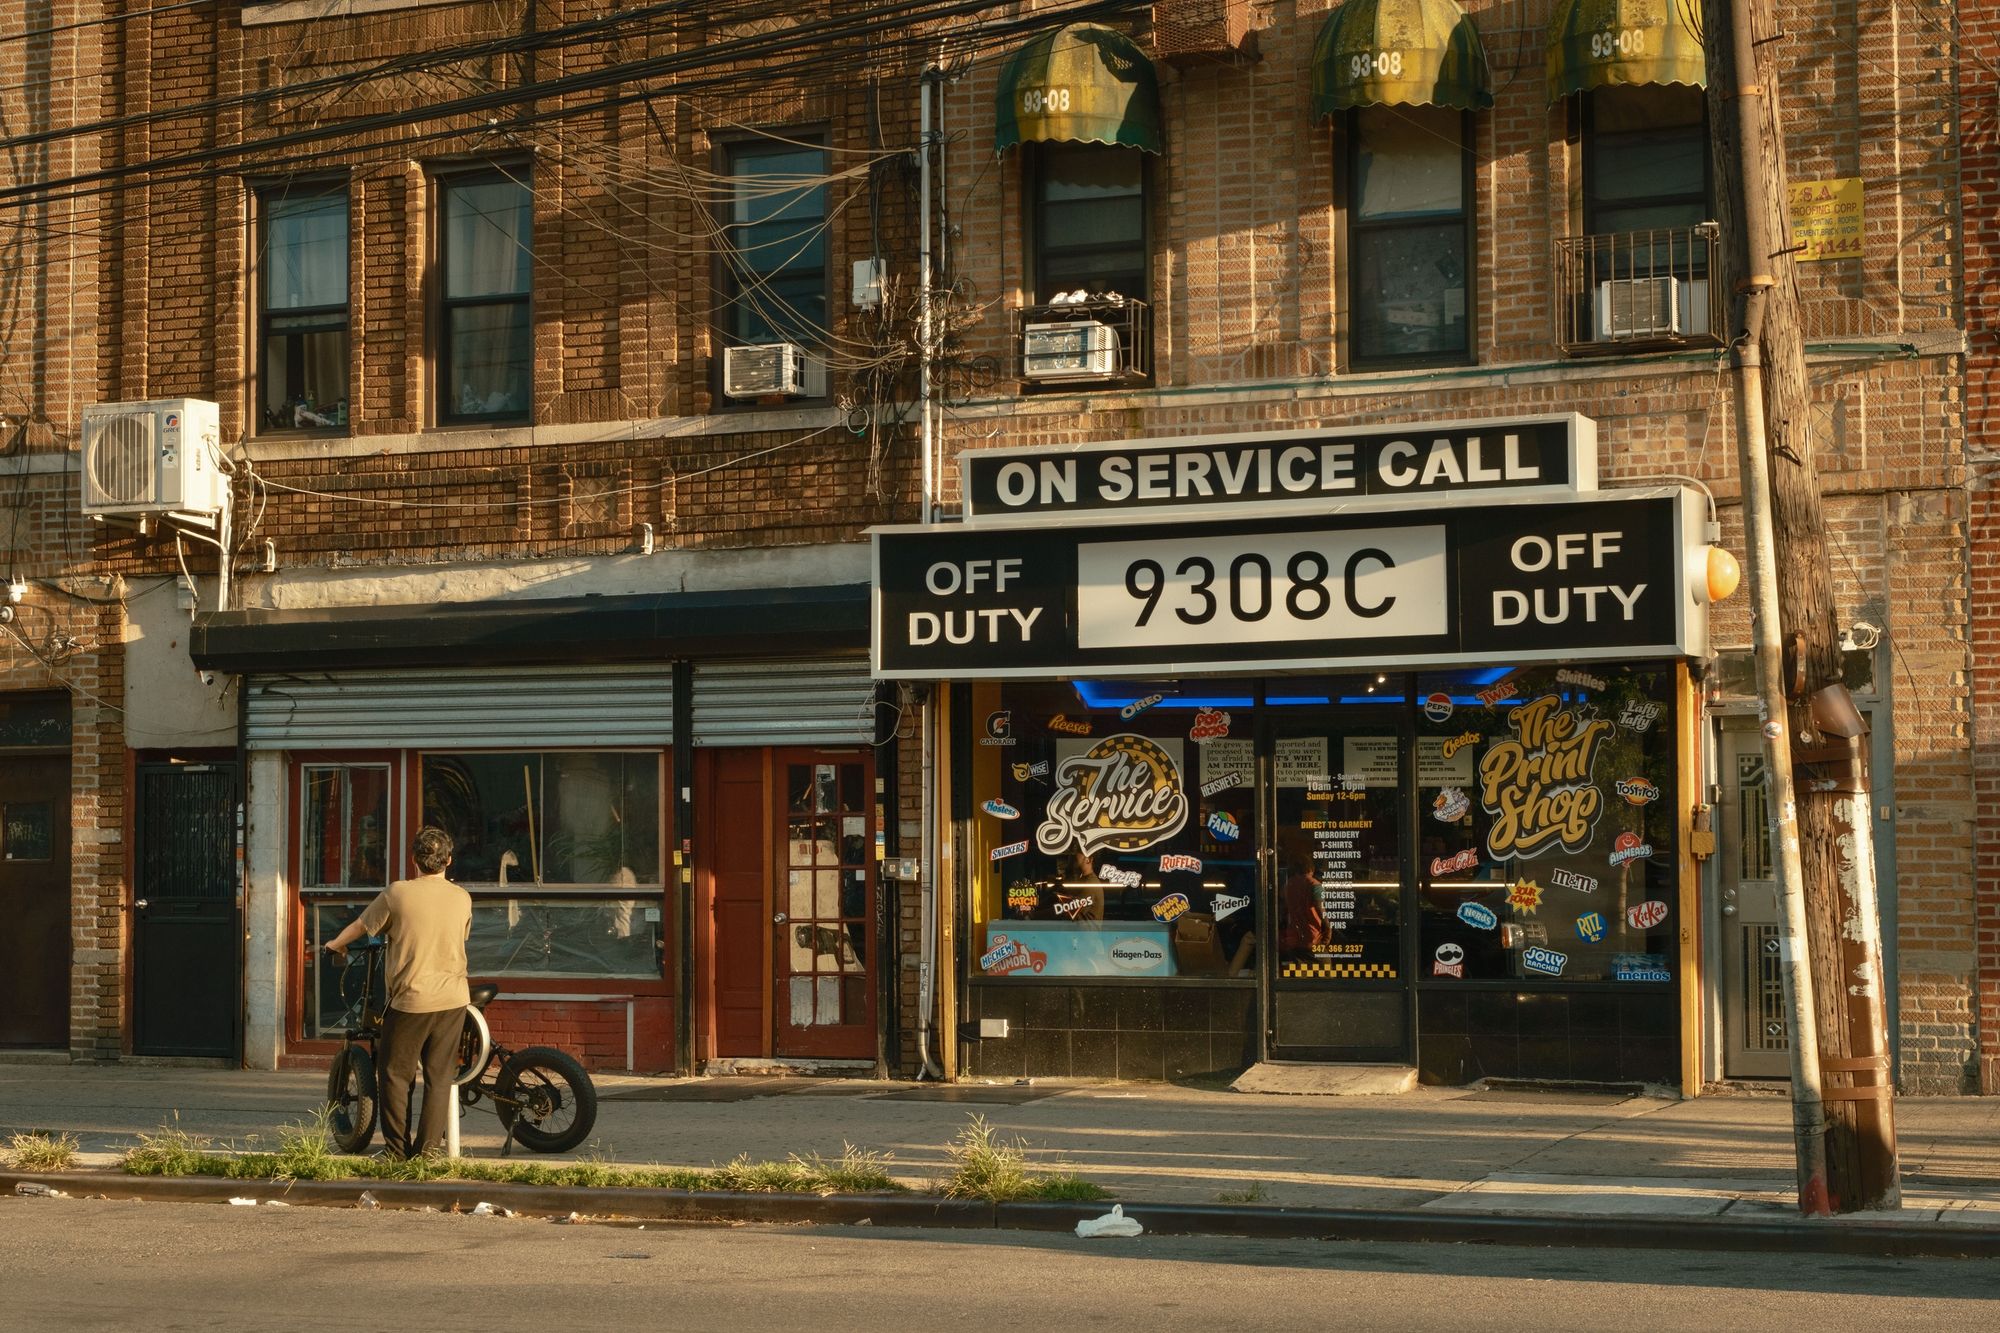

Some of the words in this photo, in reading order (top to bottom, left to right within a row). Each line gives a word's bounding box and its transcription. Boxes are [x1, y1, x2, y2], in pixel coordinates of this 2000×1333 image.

[1591, 30, 1644, 58] 93-08
[1351, 52, 1401, 78] 93-08
[1024, 89, 1070, 113] 93-08
[996, 459, 1079, 508] ON
[1099, 445, 1357, 501] SERVICE
[1379, 436, 1541, 486] CALL
[1511, 531, 1623, 573] OFF
[925, 558, 1023, 596] OFF
[1124, 549, 1397, 628] 9308C
[1493, 584, 1648, 627] DUTY
[909, 607, 1043, 647] DUTY
[1556, 669, 1606, 692] Skittles
[1121, 694, 1162, 718] OREO
[1427, 703, 1451, 713] PEPSI
[1627, 700, 1659, 718] Laffy
[1197, 712, 1221, 726] POP
[1510, 696, 1574, 748] The
[1620, 712, 1649, 731] Taffy
[1443, 731, 1480, 759] Cheetos
[1030, 763, 1046, 775] WISE
[1482, 721, 1609, 804] Print
[1057, 750, 1151, 802] The
[1307, 774, 1331, 783] Monday
[1337, 773, 1366, 783] Saturday
[1308, 782, 1331, 791] 10am
[1342, 781, 1366, 792] 10pm
[1306, 792, 1334, 801] Sunday
[1337, 792, 1366, 801] 12-6pm
[986, 801, 1016, 816] Hostess
[1489, 782, 1598, 849] Shop
[1039, 786, 1182, 848] Service
[1301, 821, 1326, 829] DIRECT
[1328, 821, 1337, 829] TO
[1339, 820, 1373, 829] GARMENT
[1207, 813, 1239, 839] FANTA
[1314, 831, 1360, 839] EMBROIDERY
[992, 842, 1025, 859] SNICKERS
[1321, 841, 1353, 849] T-SHIRTS
[1313, 851, 1361, 859] SWEATSHIRTS
[1610, 846, 1651, 864] AIRHEADS
[1162, 856, 1200, 872] RUFFLES
[1328, 861, 1346, 869] HATS
[1322, 871, 1353, 879] JACKETS
[1009, 888, 1035, 898] SOUR
[1321, 891, 1355, 899] STICKERS
[1515, 886, 1536, 896] SOUR
[1008, 897, 1037, 906] PATCH
[1054, 896, 1093, 915] Doritos
[1212, 896, 1249, 912] Trident
[1321, 901, 1355, 909] LIGHTERS
[1510, 895, 1537, 907] POWER
[1322, 911, 1354, 919] POSTERS
[1330, 921, 1347, 929] PINS
[1577, 913, 1602, 937] RITZ
[1112, 949, 1162, 960] Häagen-Dazs
[1312, 945, 1326, 953] 347
[1328, 945, 1343, 953] 366
[1345, 945, 1364, 953] 2337
[1525, 948, 1565, 966] JOLLY
[1434, 962, 1462, 977] PRINGLES
[1526, 960, 1560, 973] RANCHER
[1618, 970, 1670, 981] mentos
